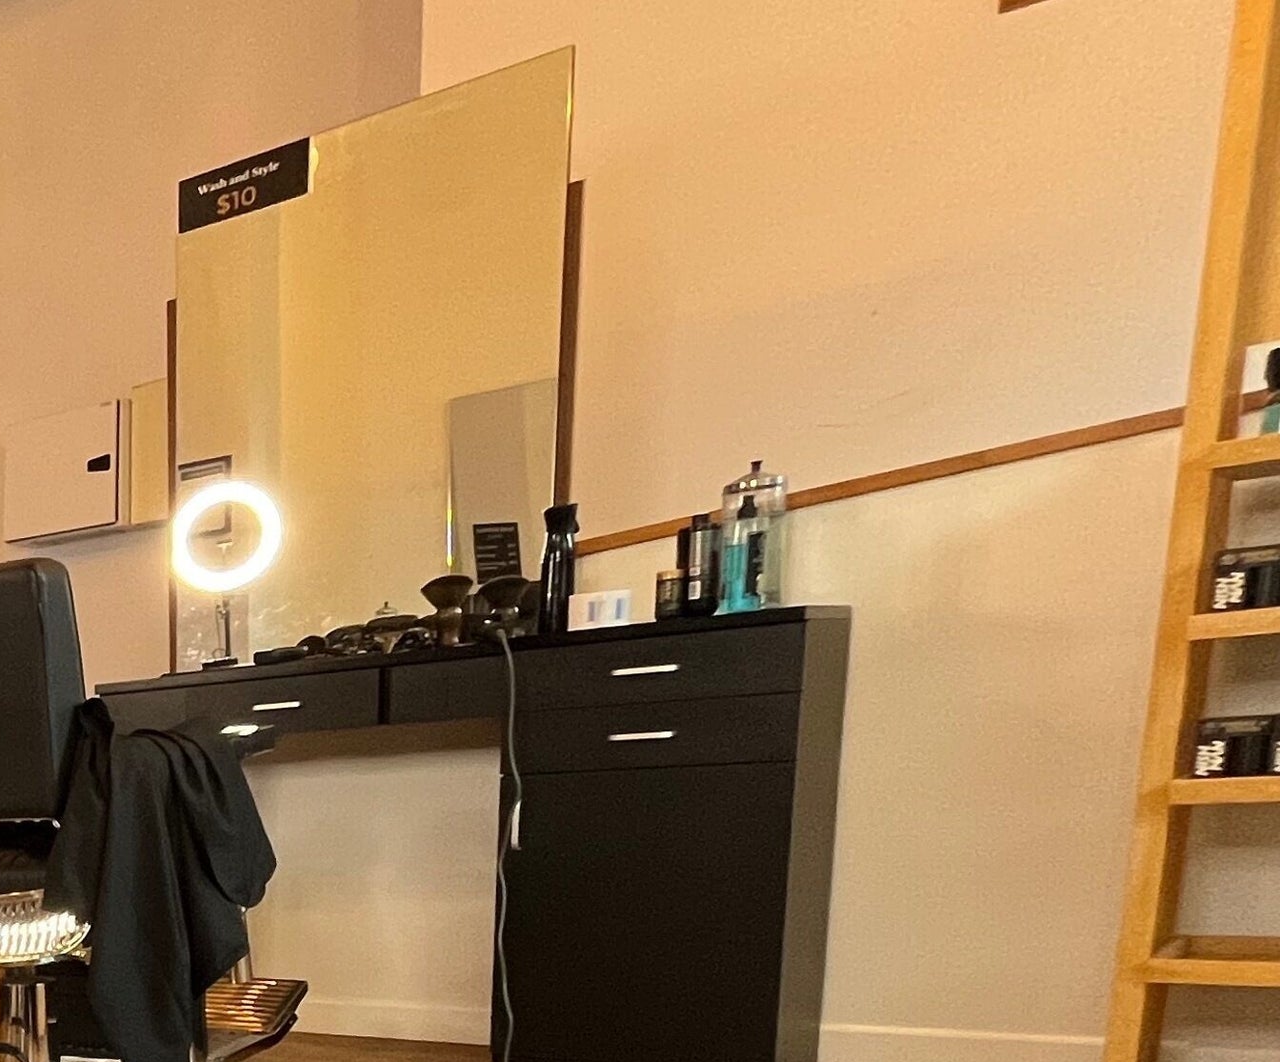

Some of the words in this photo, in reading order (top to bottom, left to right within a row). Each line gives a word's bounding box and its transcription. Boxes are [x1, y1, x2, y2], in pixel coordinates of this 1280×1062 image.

[197, 178, 228, 195] Wash
[228, 169, 250, 186] and
[251, 161, 280, 177] Style
[216, 185, 257, 215] $10
